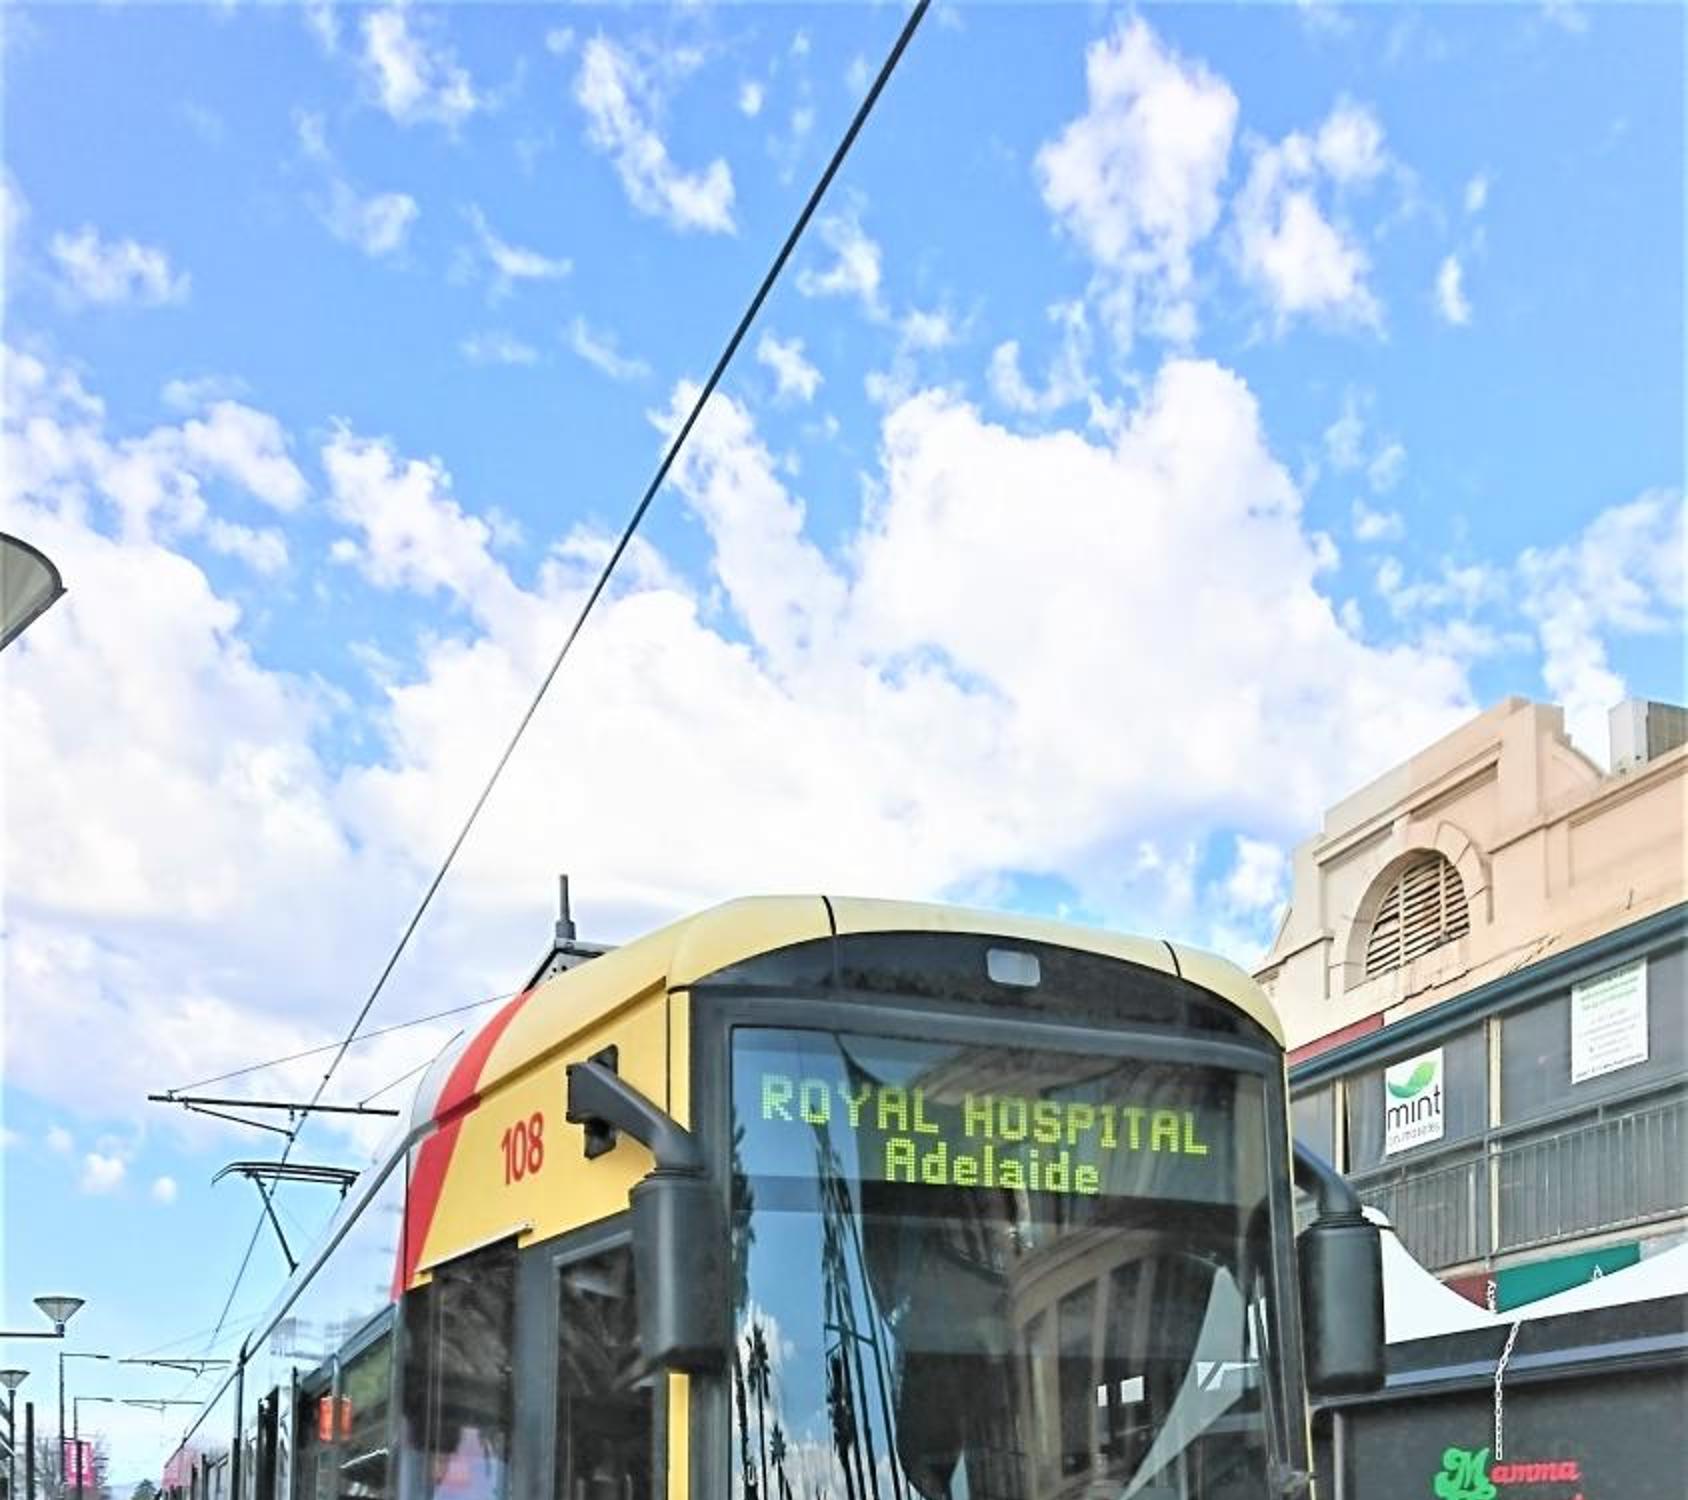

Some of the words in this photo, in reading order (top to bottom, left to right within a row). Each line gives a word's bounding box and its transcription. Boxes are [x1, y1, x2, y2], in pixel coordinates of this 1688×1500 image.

[760, 1072, 939, 1135] ROYAL
[963, 1093, 1208, 1156] HOSPITAL
[1387, 1083, 1441, 1132] mint
[501, 1111, 544, 1186] 108
[885, 1137, 1099, 1195] Adelaide
[1434, 1447, 1582, 1491] Mamma
